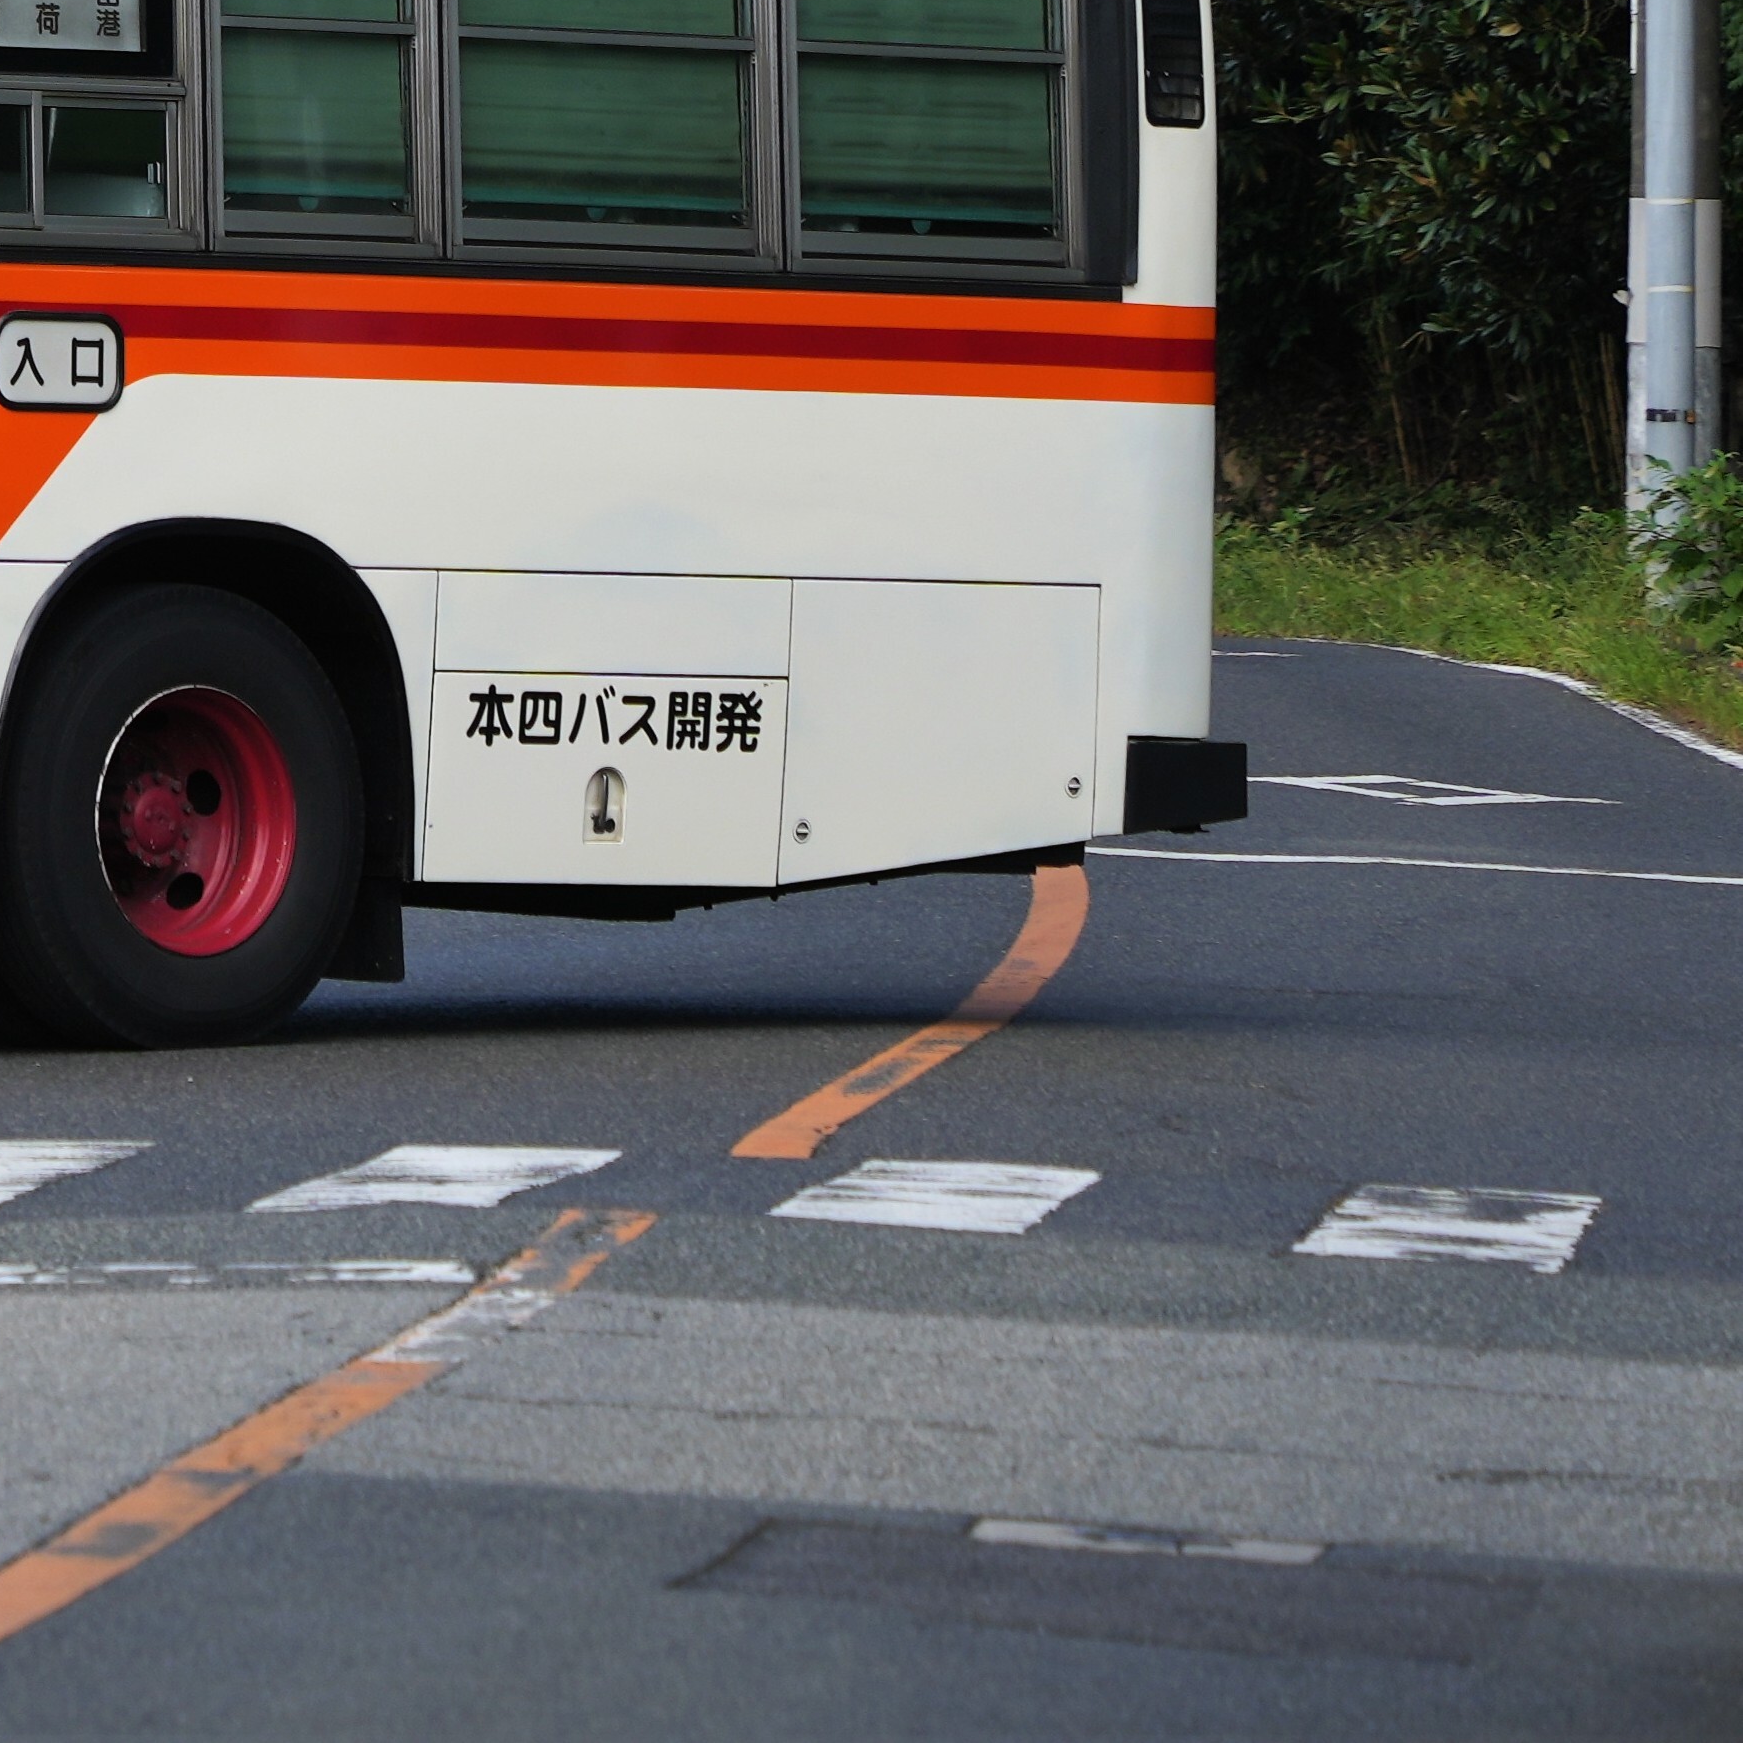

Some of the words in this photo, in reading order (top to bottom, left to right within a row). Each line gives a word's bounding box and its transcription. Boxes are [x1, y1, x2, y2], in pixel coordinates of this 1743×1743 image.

[10, 337, 104, 387] 入口
[466, 684, 763, 753] 本四バス開発
